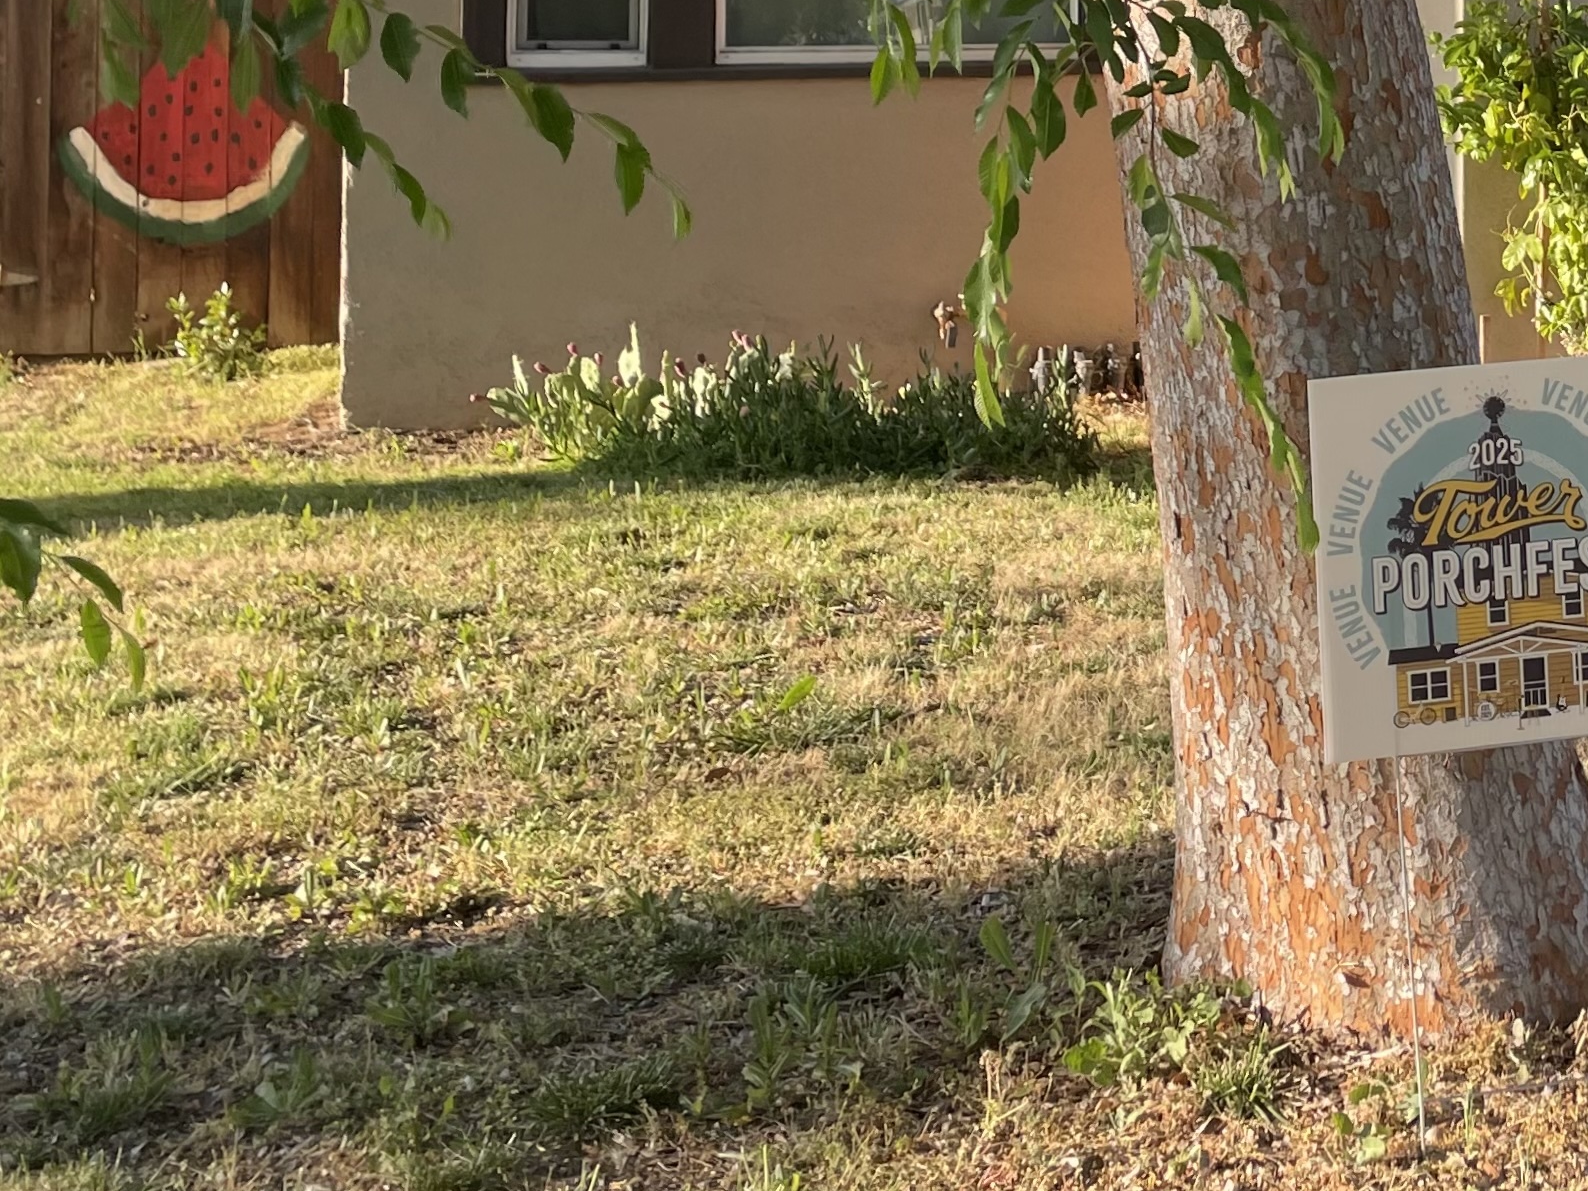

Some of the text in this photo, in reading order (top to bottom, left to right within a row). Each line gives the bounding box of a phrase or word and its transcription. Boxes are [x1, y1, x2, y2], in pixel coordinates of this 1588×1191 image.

[1371, 387, 1451, 455] VENUE
[1468, 437, 1524, 471] 2025
[1326, 469, 1373, 558] VENUE
[1413, 478, 1587, 546] Tower
[1329, 583, 1382, 671] VENUE
